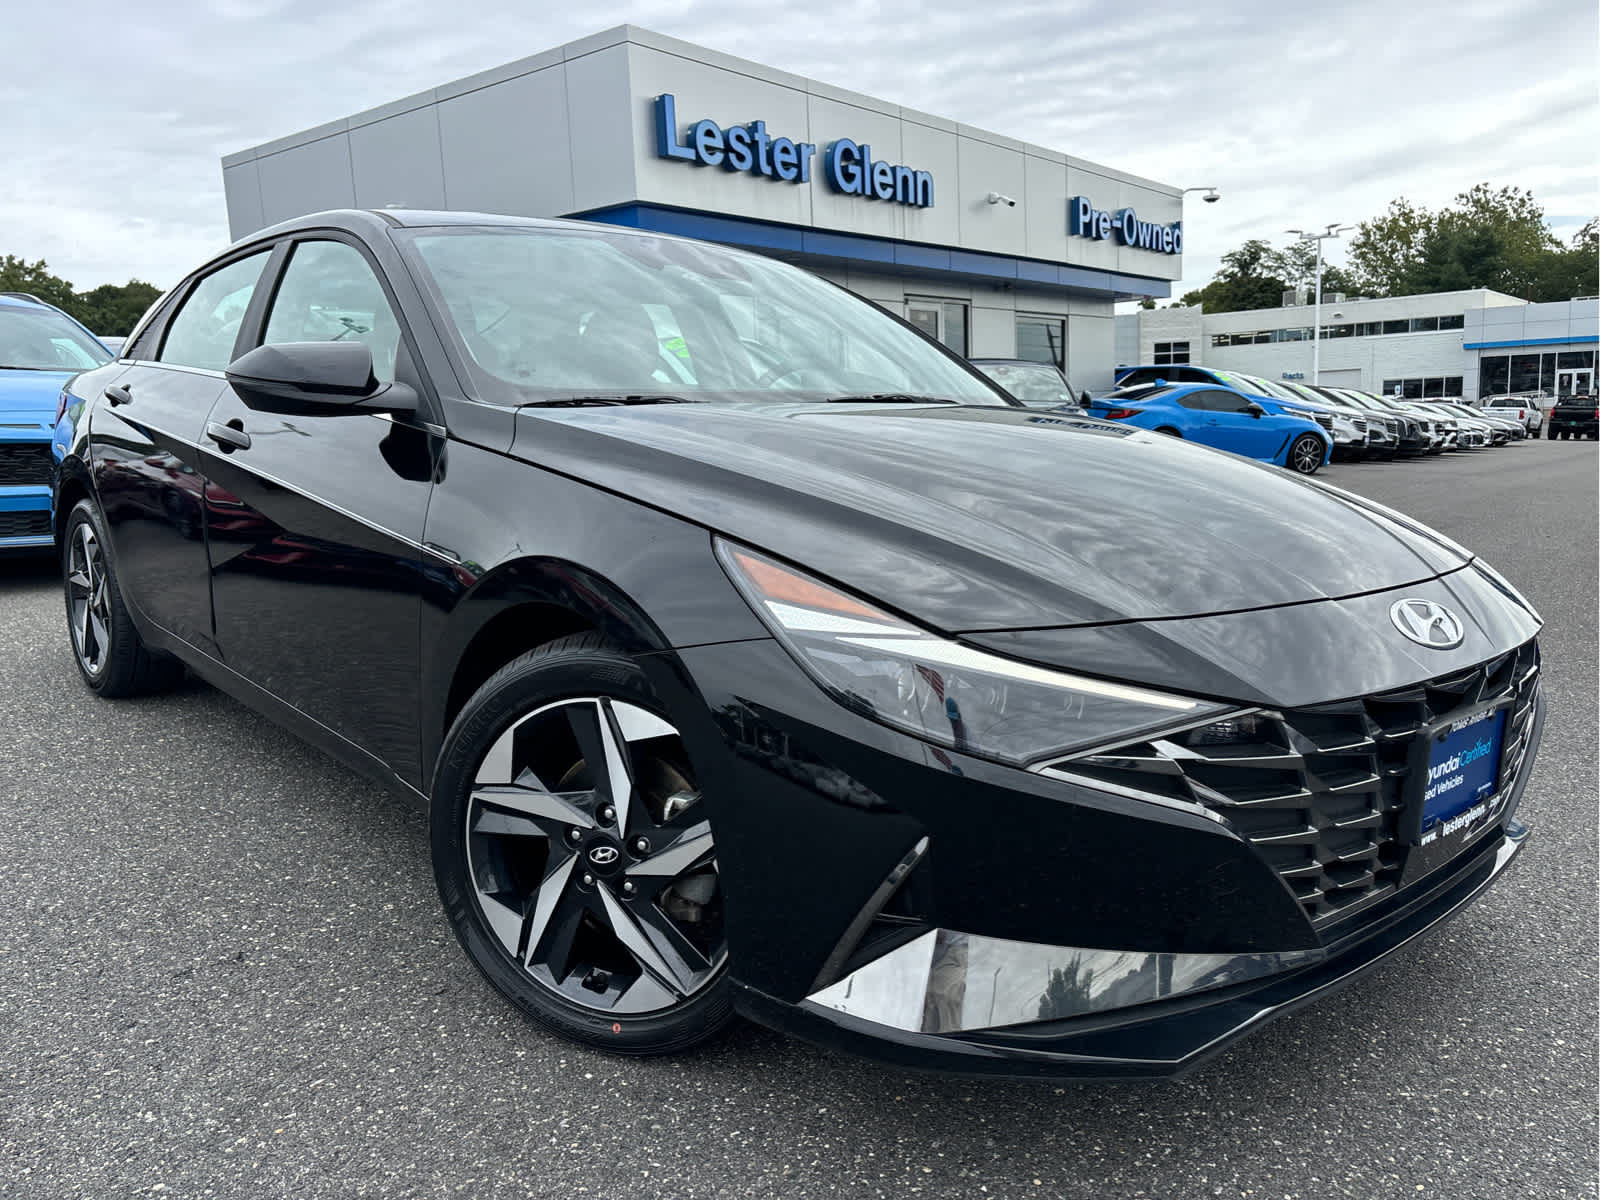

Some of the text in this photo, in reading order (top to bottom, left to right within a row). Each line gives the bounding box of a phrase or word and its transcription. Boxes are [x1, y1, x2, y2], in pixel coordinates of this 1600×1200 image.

[655, 94, 934, 208] Lester Glenn
[1071, 196, 1182, 254] Pre-Owned
[1438, 774, 1464, 795] Vehicles
